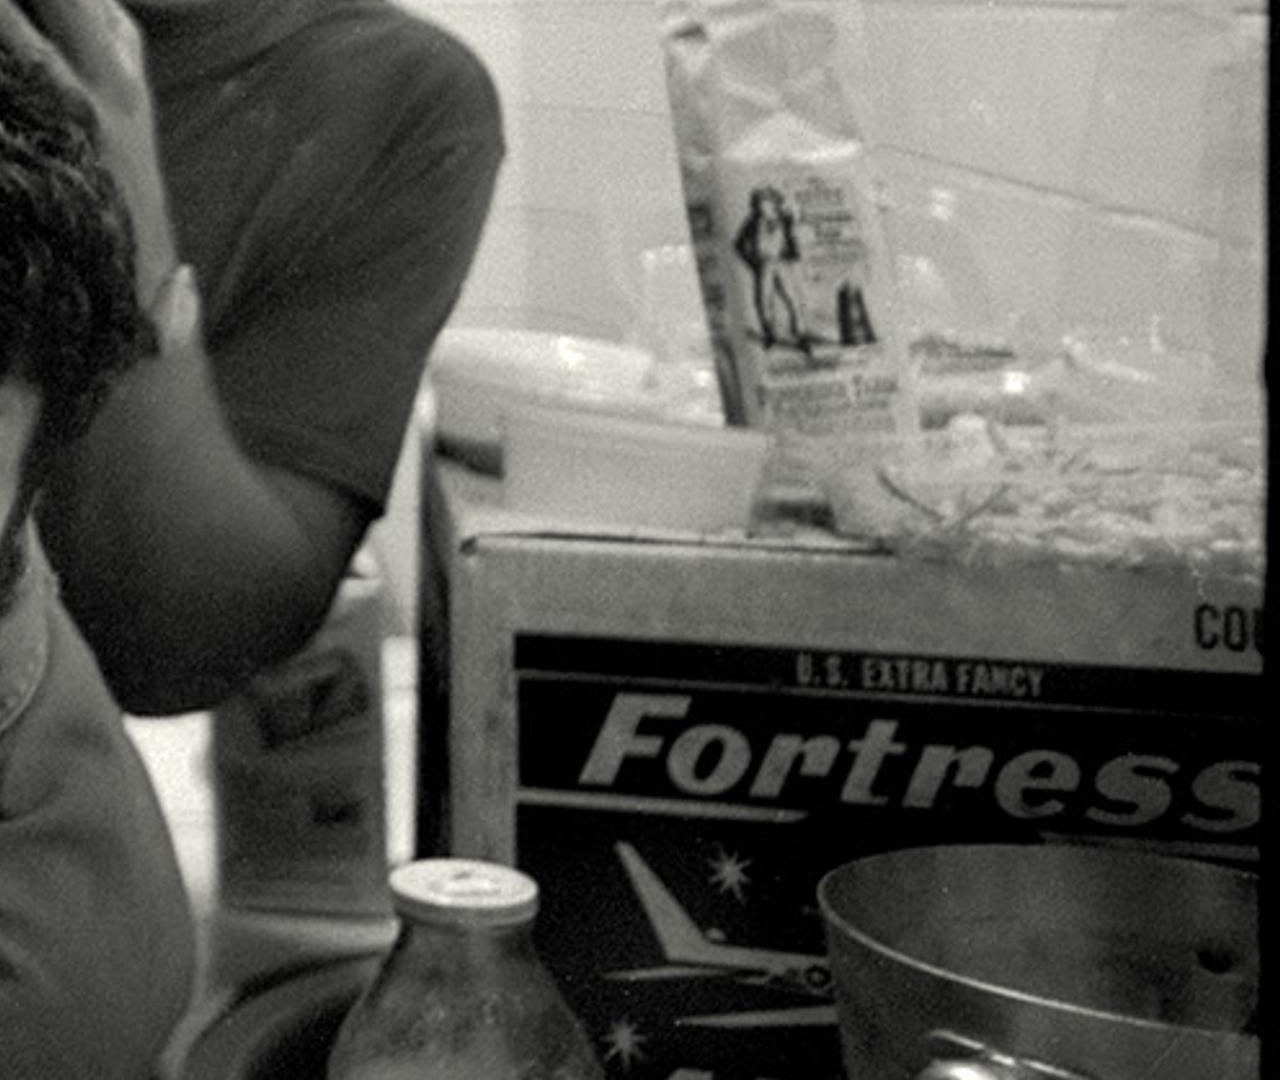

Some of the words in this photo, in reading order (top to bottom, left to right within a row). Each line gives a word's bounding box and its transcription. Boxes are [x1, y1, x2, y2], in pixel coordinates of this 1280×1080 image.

[795, 653, 849, 687] U.S.
[861, 658, 949, 692] EXTRA
[955, 662, 1044, 698] FANCY
[579, 694, 1261, 832] Fortress
